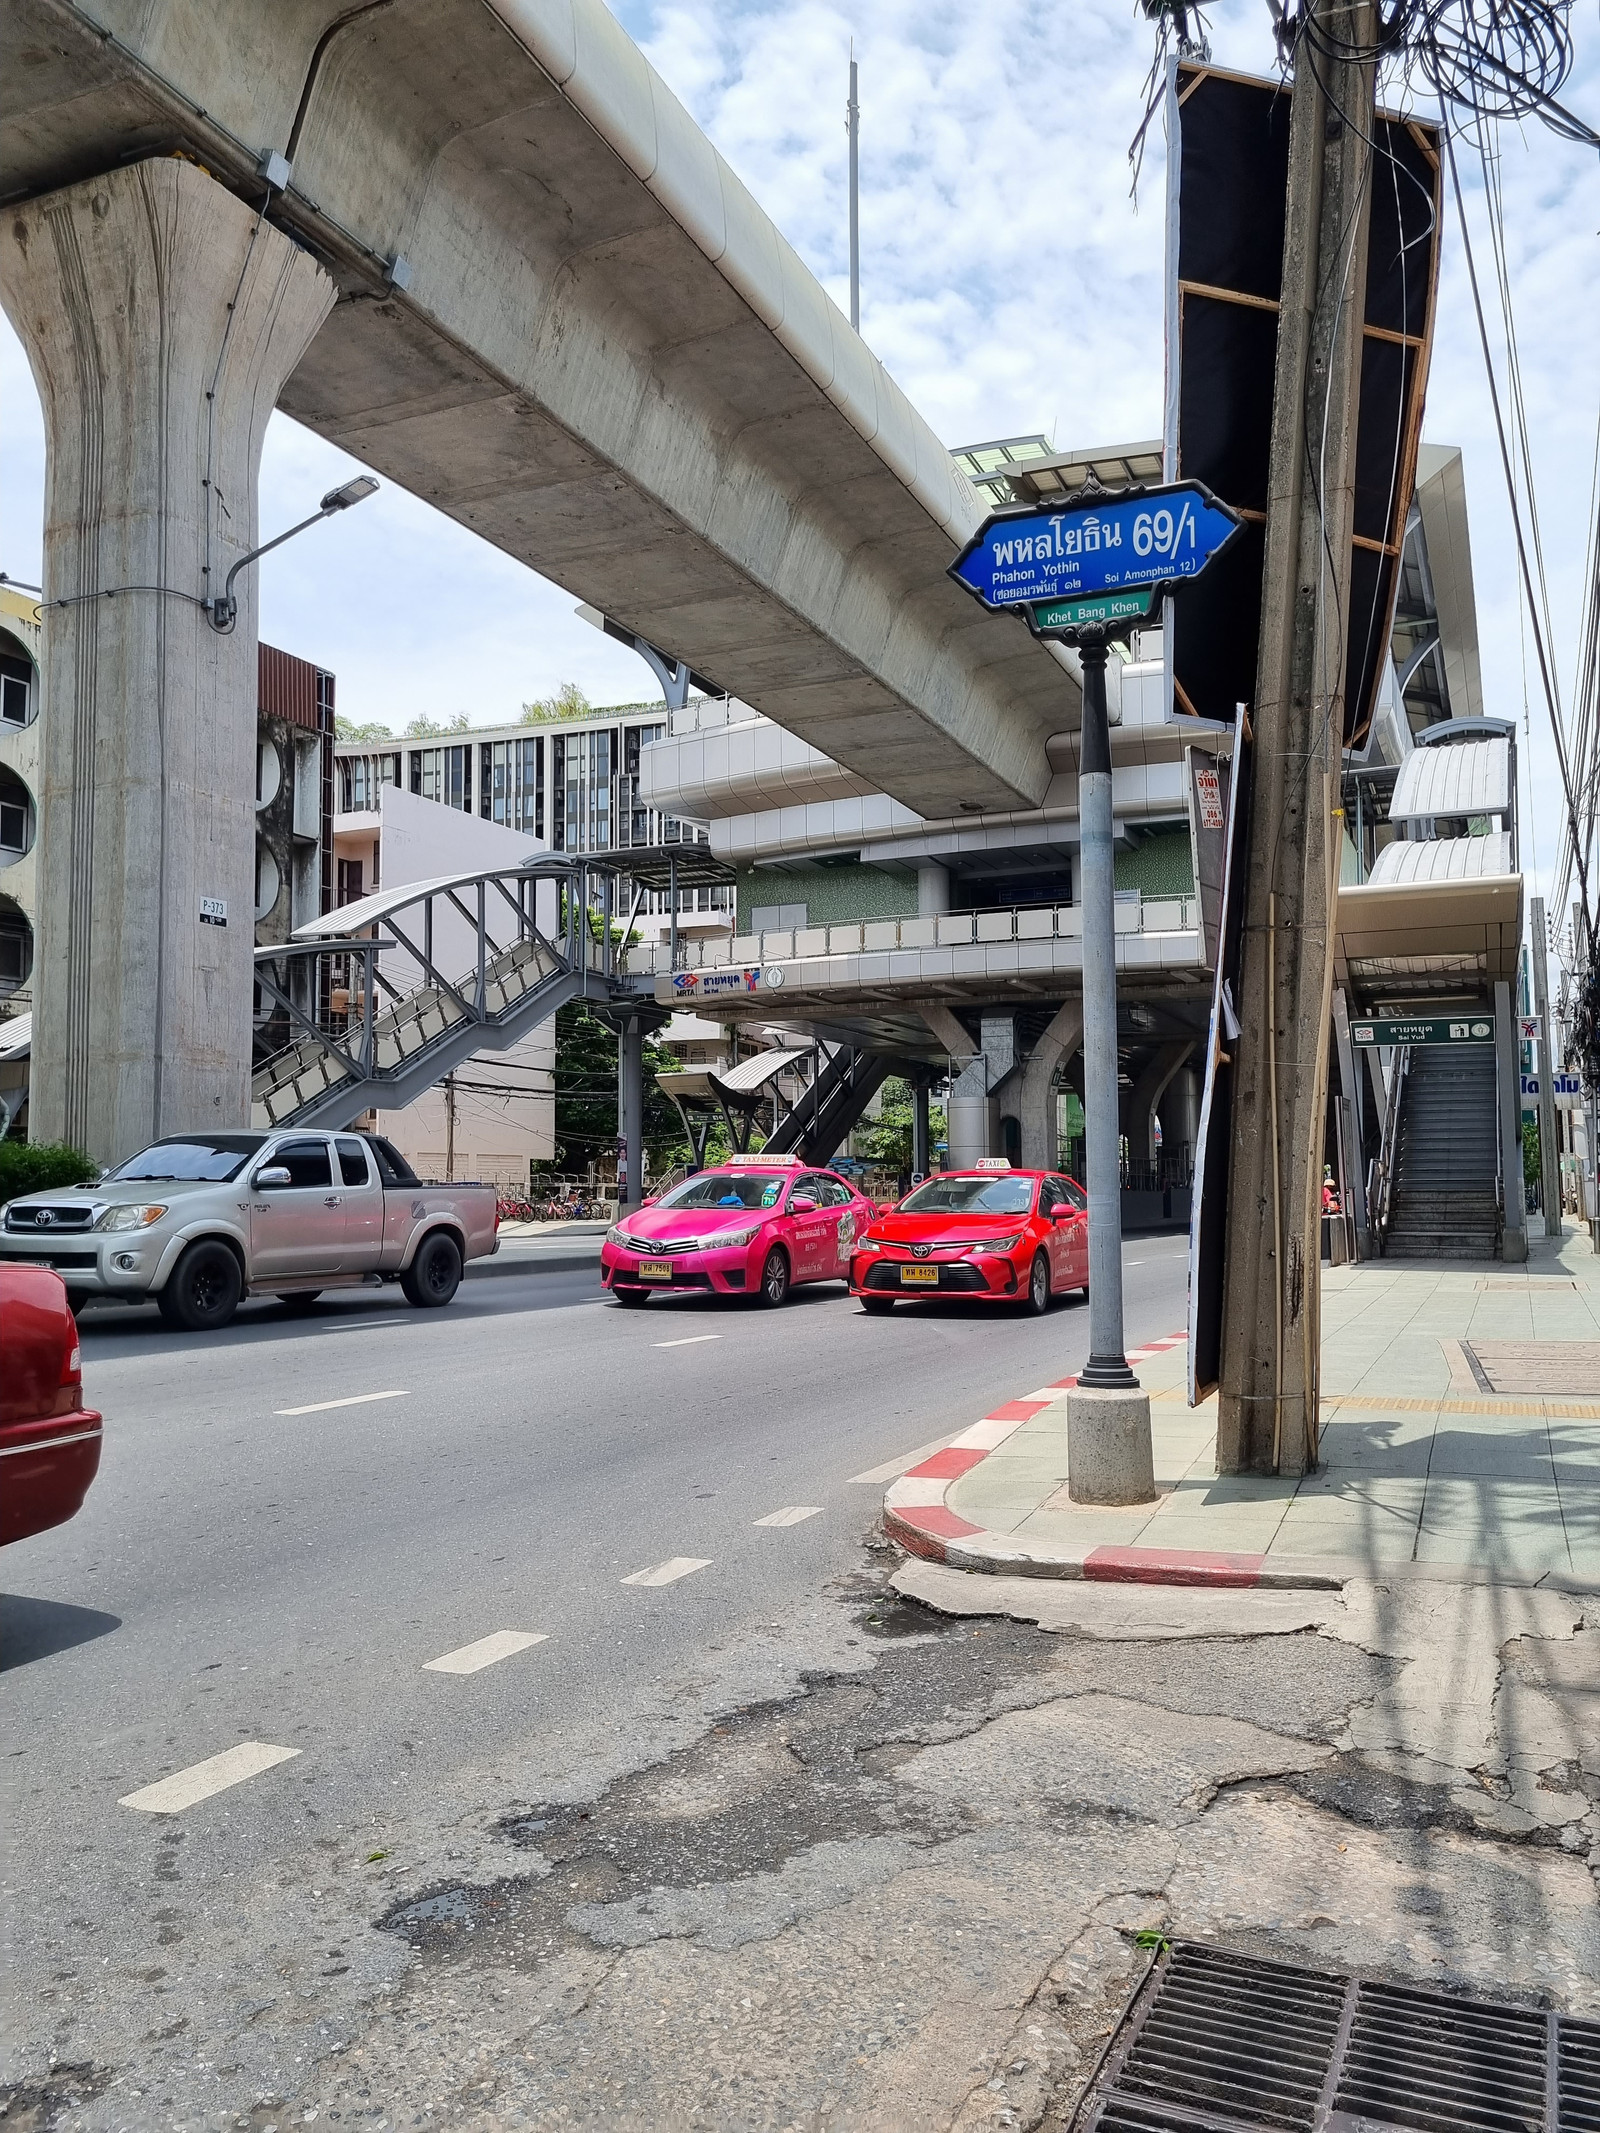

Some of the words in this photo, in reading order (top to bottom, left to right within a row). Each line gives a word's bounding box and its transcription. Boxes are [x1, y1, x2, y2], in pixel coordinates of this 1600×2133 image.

[992, 514, 1122, 567] พหลโยธิน
[1132, 502, 1196, 560] 69/1
[992, 568, 1035, 585] Phahon
[1042, 560, 1080, 578] Yothin
[1104, 572, 1120, 584] Soi
[1124, 563, 1175, 580] Amonphan
[1179, 557, 1196, 573] 12)
[1047, 611, 1072, 625] Khet
[1078, 606, 1106, 621] Bang
[1111, 601, 1139, 615] Khen
[203, 899, 224, 915] P-373
[703, 974, 740, 988] สายหยุด
[676, 989, 695, 997] MRTA
[1390, 1025, 1433, 1035] สายหยุด
[1520, 1074, 1579, 1094] ไดาโม
